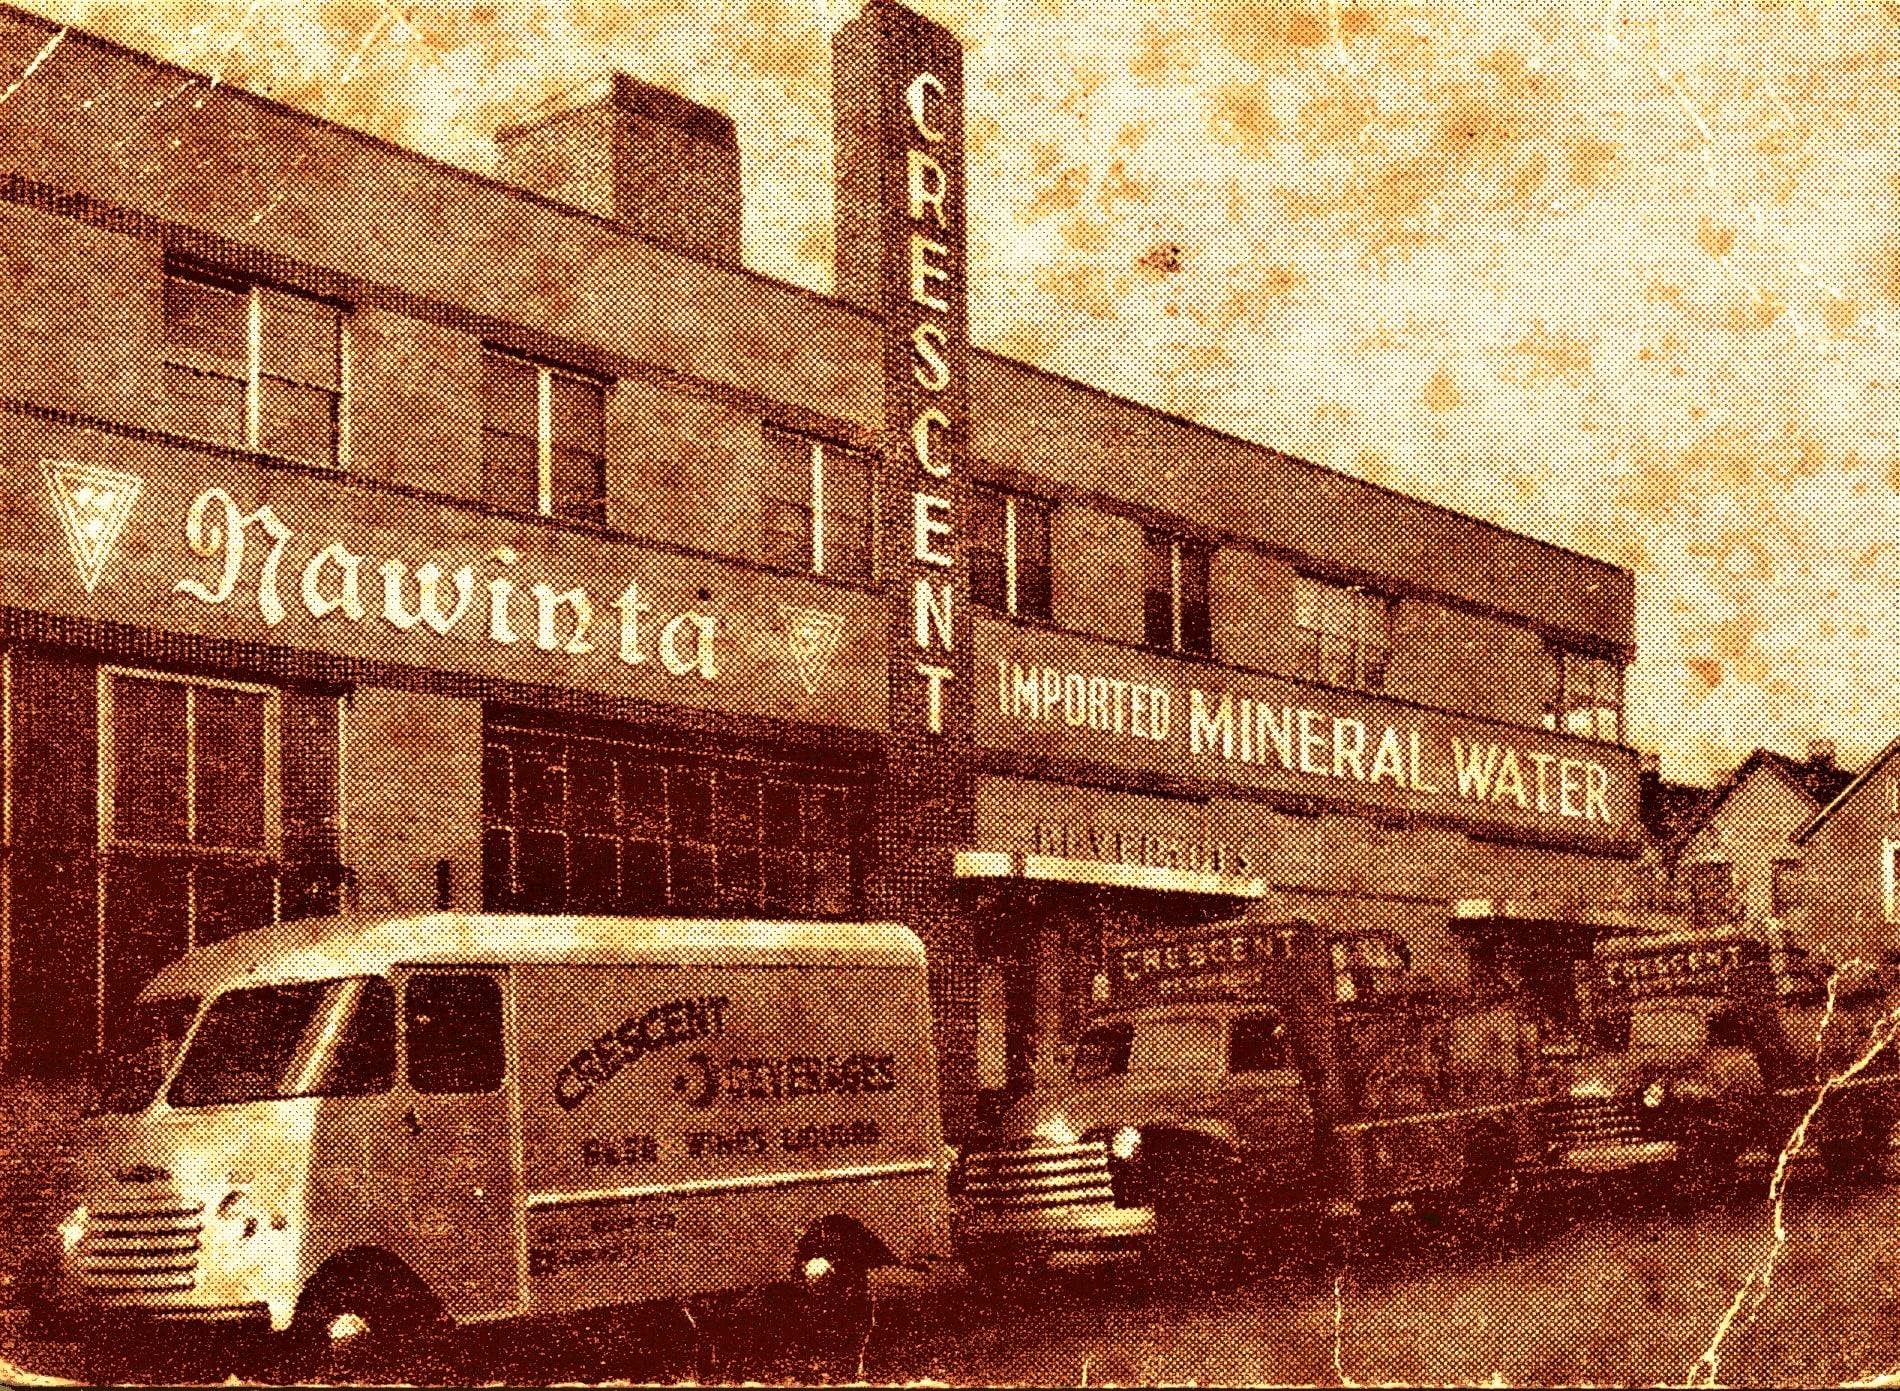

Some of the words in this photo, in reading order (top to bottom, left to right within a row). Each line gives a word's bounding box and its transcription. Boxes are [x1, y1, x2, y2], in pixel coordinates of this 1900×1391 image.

[906, 71, 954, 734] CRESCENT
[172, 486, 722, 681] Nawinta
[998, 658, 1171, 742] IMPORTED
[1189, 688, 1440, 795] MINERAL
[1450, 737, 1613, 823] WATER
[1121, 929, 1297, 982] CRESCENT
[554, 995, 729, 1112] CRESCENT
[725, 1053, 895, 1100] BEVERAGES
